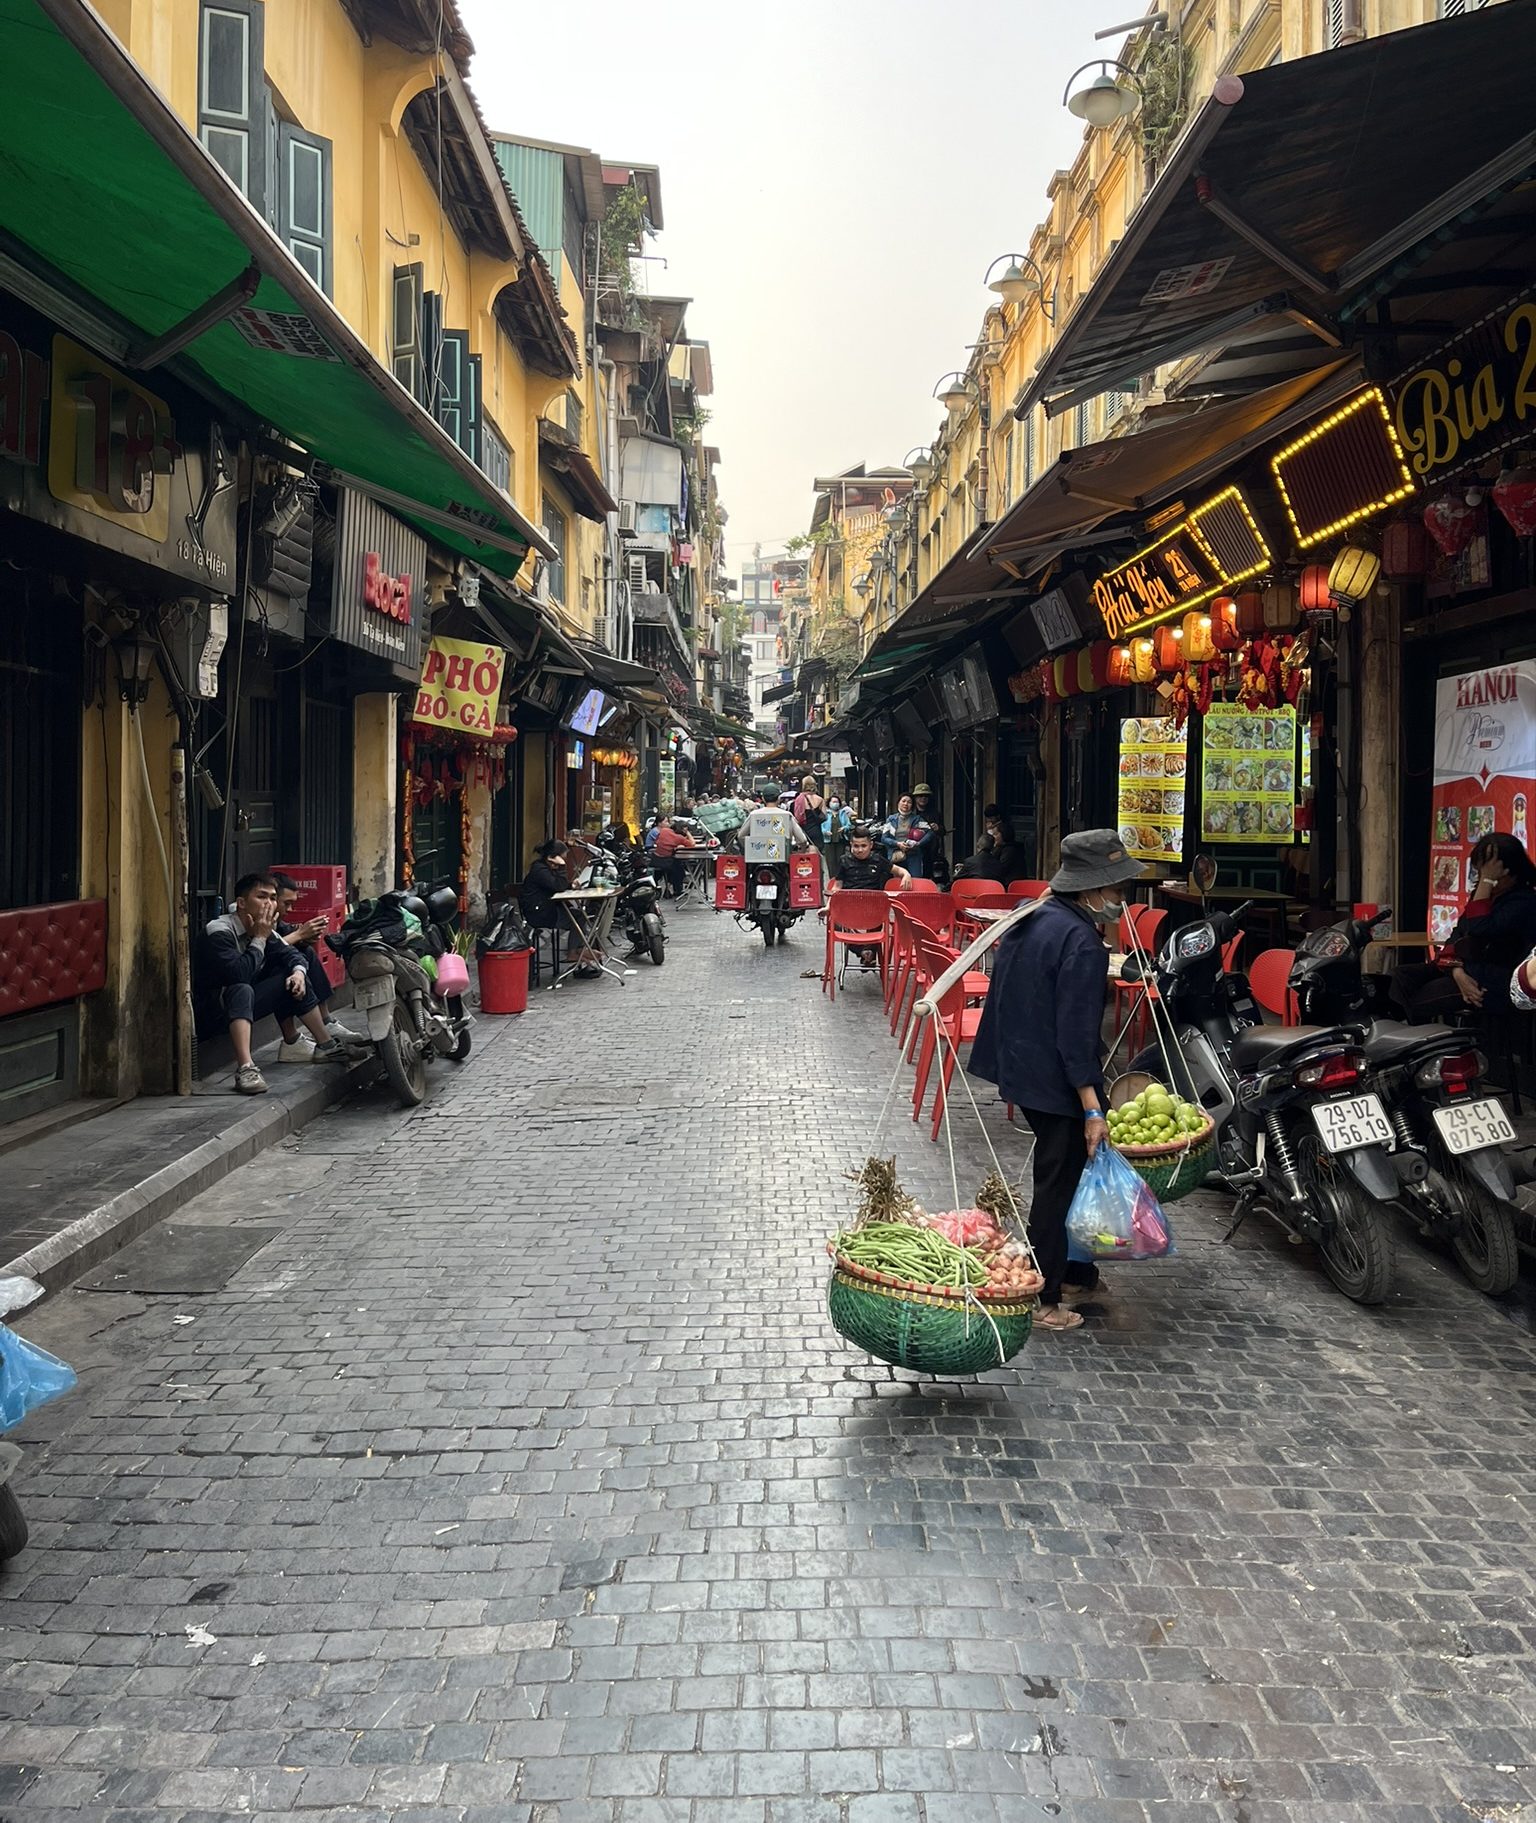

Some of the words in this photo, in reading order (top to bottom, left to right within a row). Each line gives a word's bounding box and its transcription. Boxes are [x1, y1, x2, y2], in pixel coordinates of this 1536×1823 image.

[1396, 359, 1504, 474] Bia
[176, 538, 189, 560] 18
[192, 544, 204, 570] Tạ
[205, 551, 228, 577] Hiện
[1165, 549, 1189, 578] 21
[423, 647, 501, 696] PHỞ
[1456, 666, 1518, 709] HANOI
[751, 841, 766, 851] Tiger
[1329, 1091, 1351, 1099] HONDA
[1450, 1096, 1472, 1104] HONDA
[1324, 1099, 1375, 1126] 29-D2
[1444, 1102, 1496, 1130] 29-C1
[1327, 1118, 1390, 1149] 756.19
[1450, 1120, 1512, 1150] 875.80
